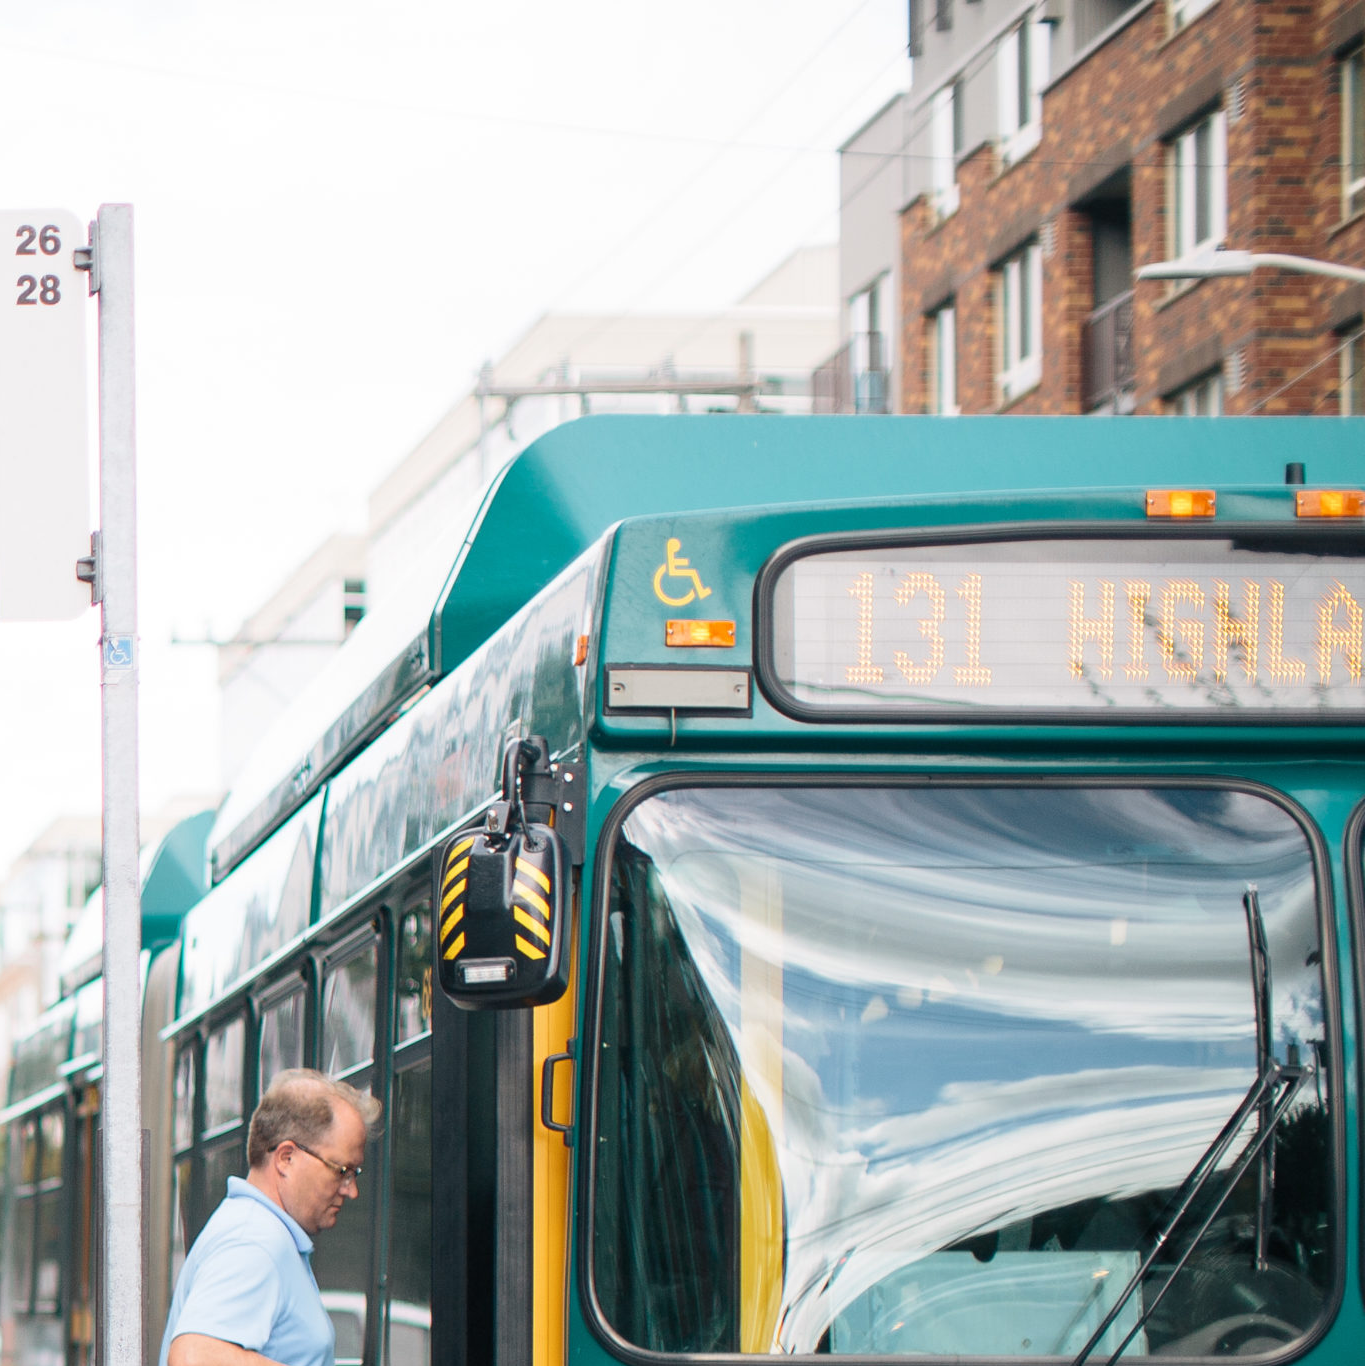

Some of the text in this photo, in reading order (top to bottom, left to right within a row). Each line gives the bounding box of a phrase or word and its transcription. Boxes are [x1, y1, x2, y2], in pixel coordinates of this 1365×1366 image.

[15, 224, 62, 257] 26
[15, 274, 62, 306] 28
[846, 572, 1365, 689] 131 HIGHLA
